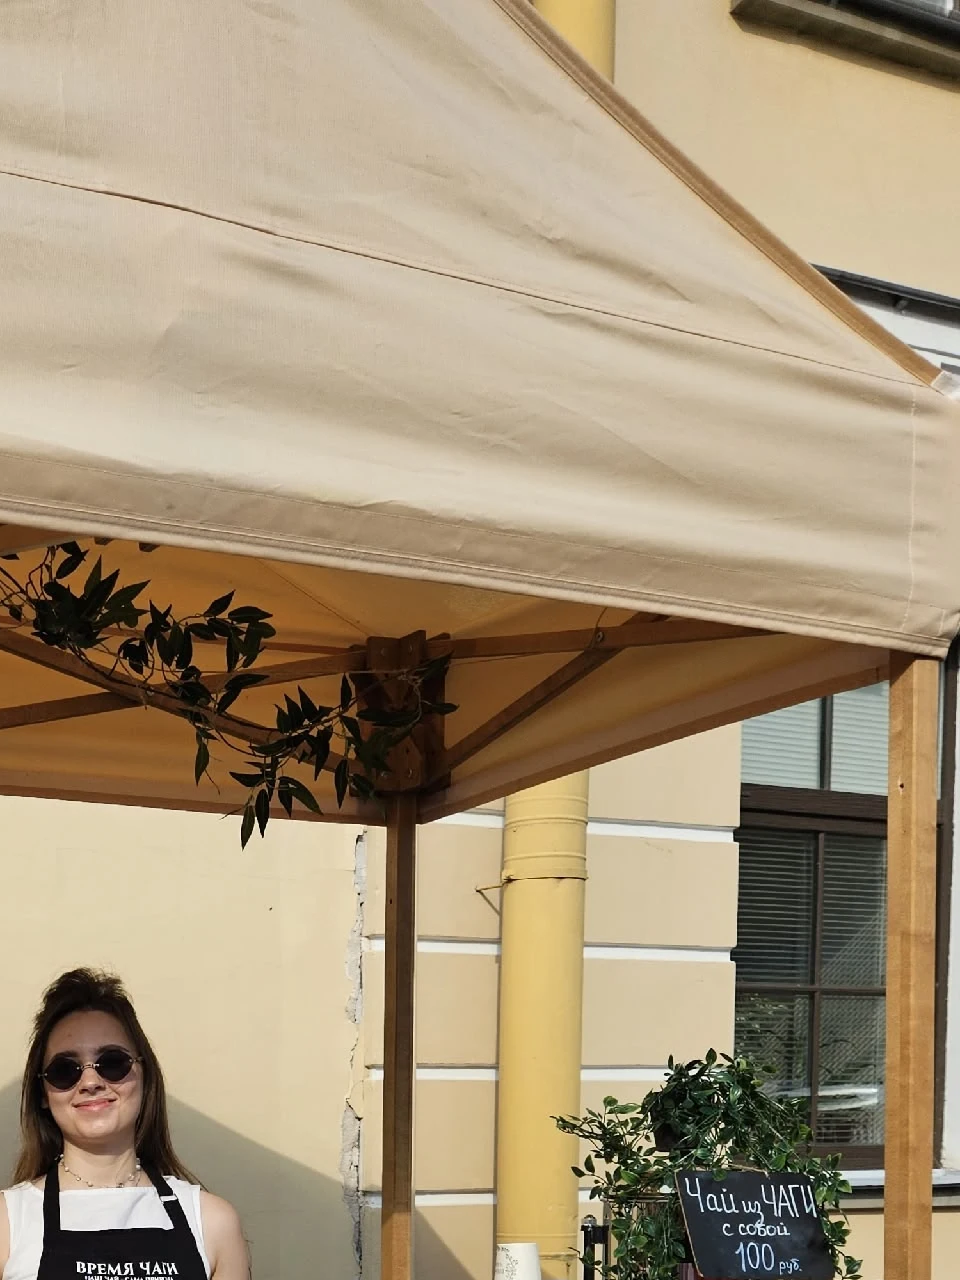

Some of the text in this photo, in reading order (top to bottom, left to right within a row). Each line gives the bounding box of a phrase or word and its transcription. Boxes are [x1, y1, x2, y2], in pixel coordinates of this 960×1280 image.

[685, 1177, 818, 1226] Чай из ЧАГИ
[739, 1222, 791, 1237] собой
[76, 1261, 180, 1276] ВРЕМЯ ЧАГИ
[734, 1241, 803, 1275] 100 руб.
